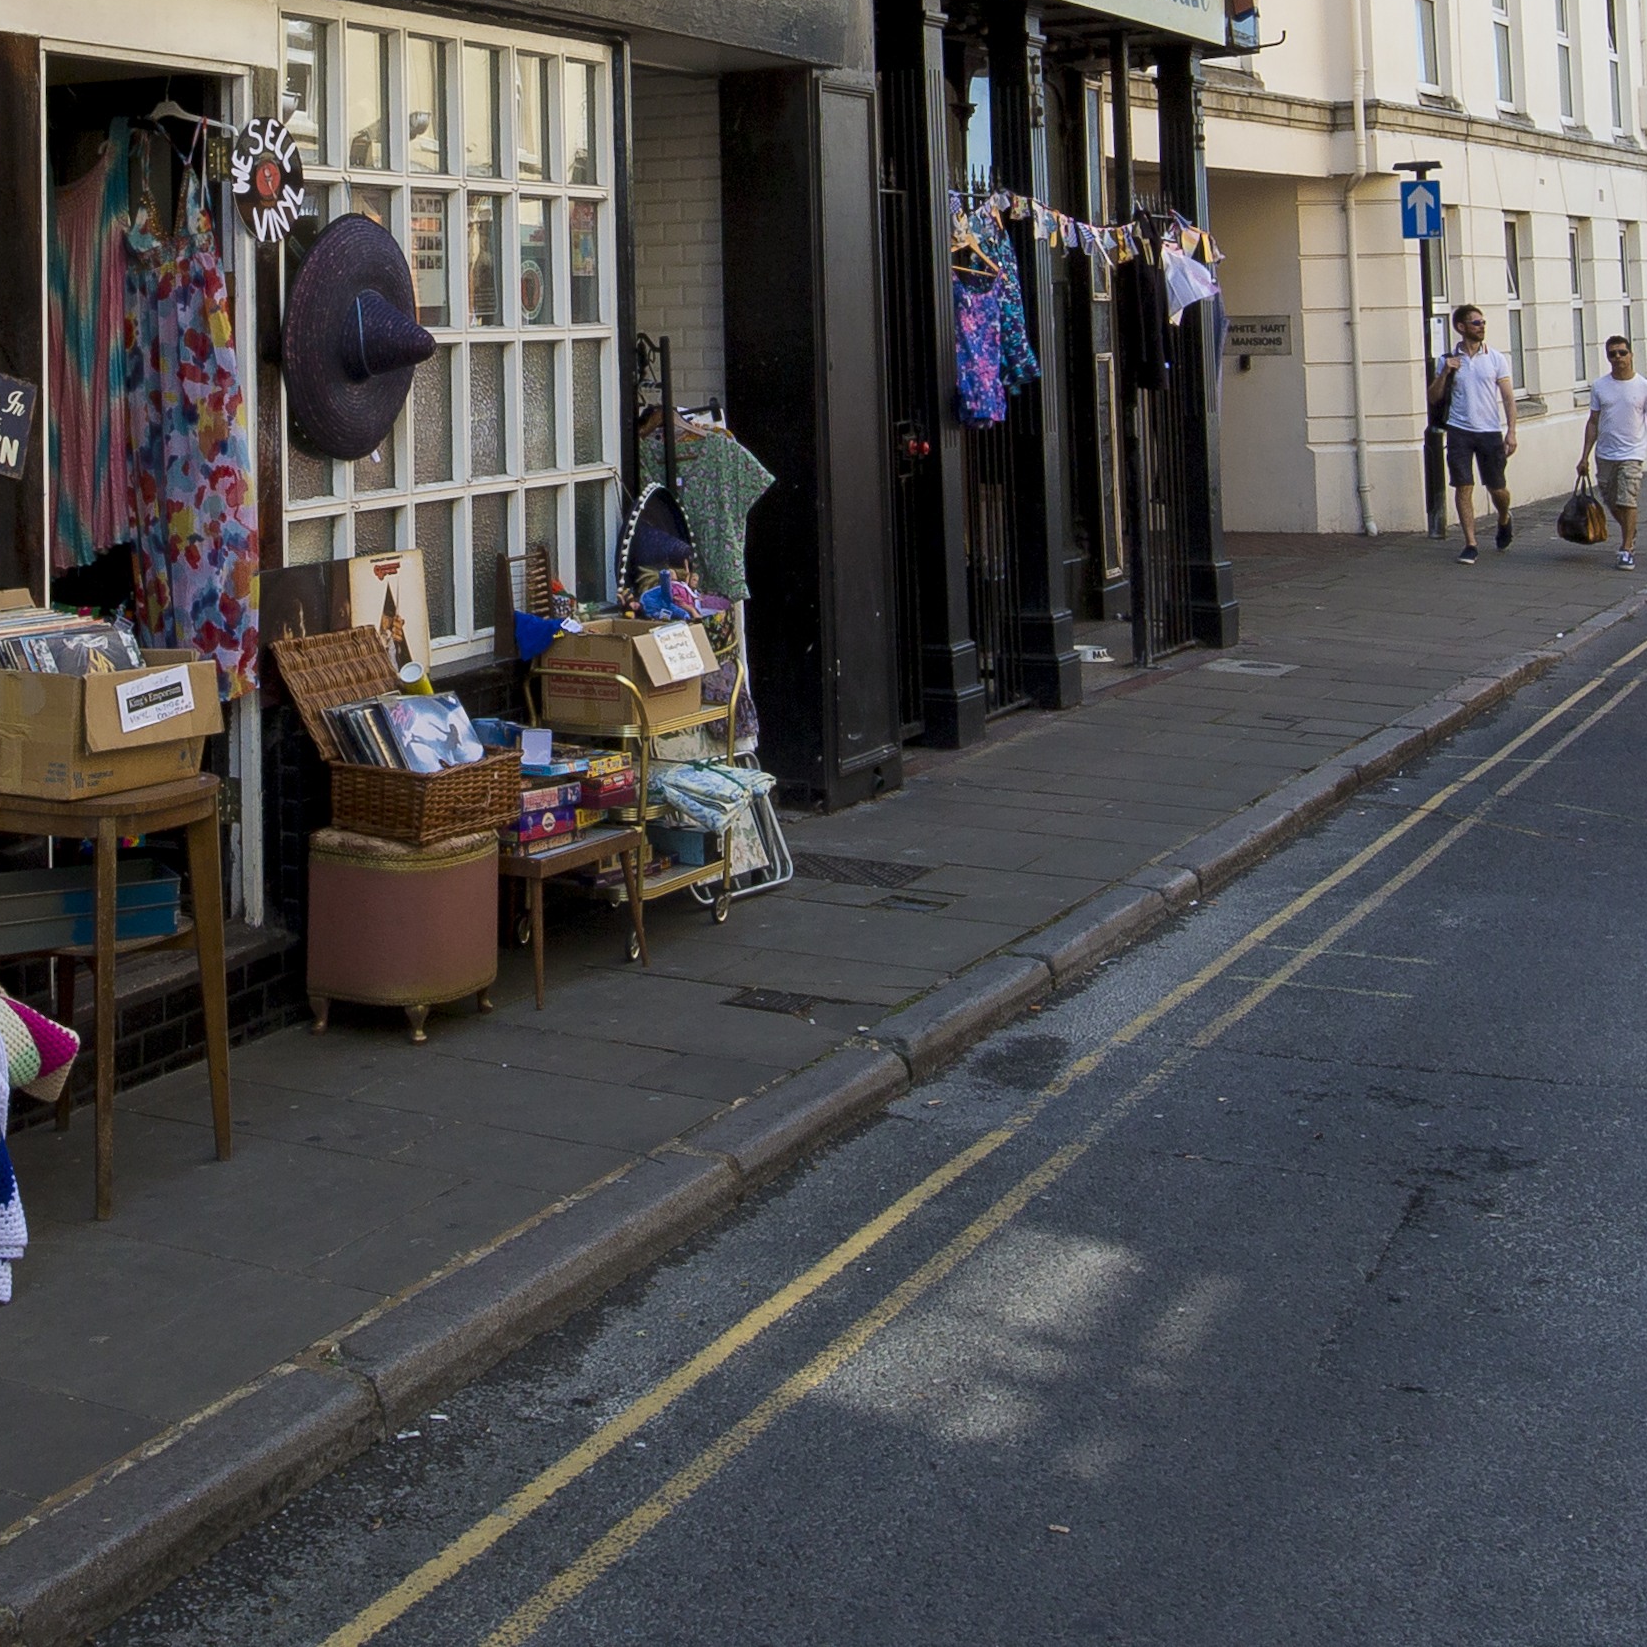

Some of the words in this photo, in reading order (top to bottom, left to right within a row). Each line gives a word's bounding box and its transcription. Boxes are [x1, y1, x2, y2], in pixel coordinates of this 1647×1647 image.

[247, 118, 297, 174] SELL
[230, 149, 254, 194] WE
[252, 183, 305, 243] VINYL
[1227, 324, 1257, 333] WHITE
[1260, 324, 1286, 333] HART
[1231, 336, 1283, 346] MANSIONS
[1, 390, 26, 417] In
[148, 685, 182, 703] Emporium
